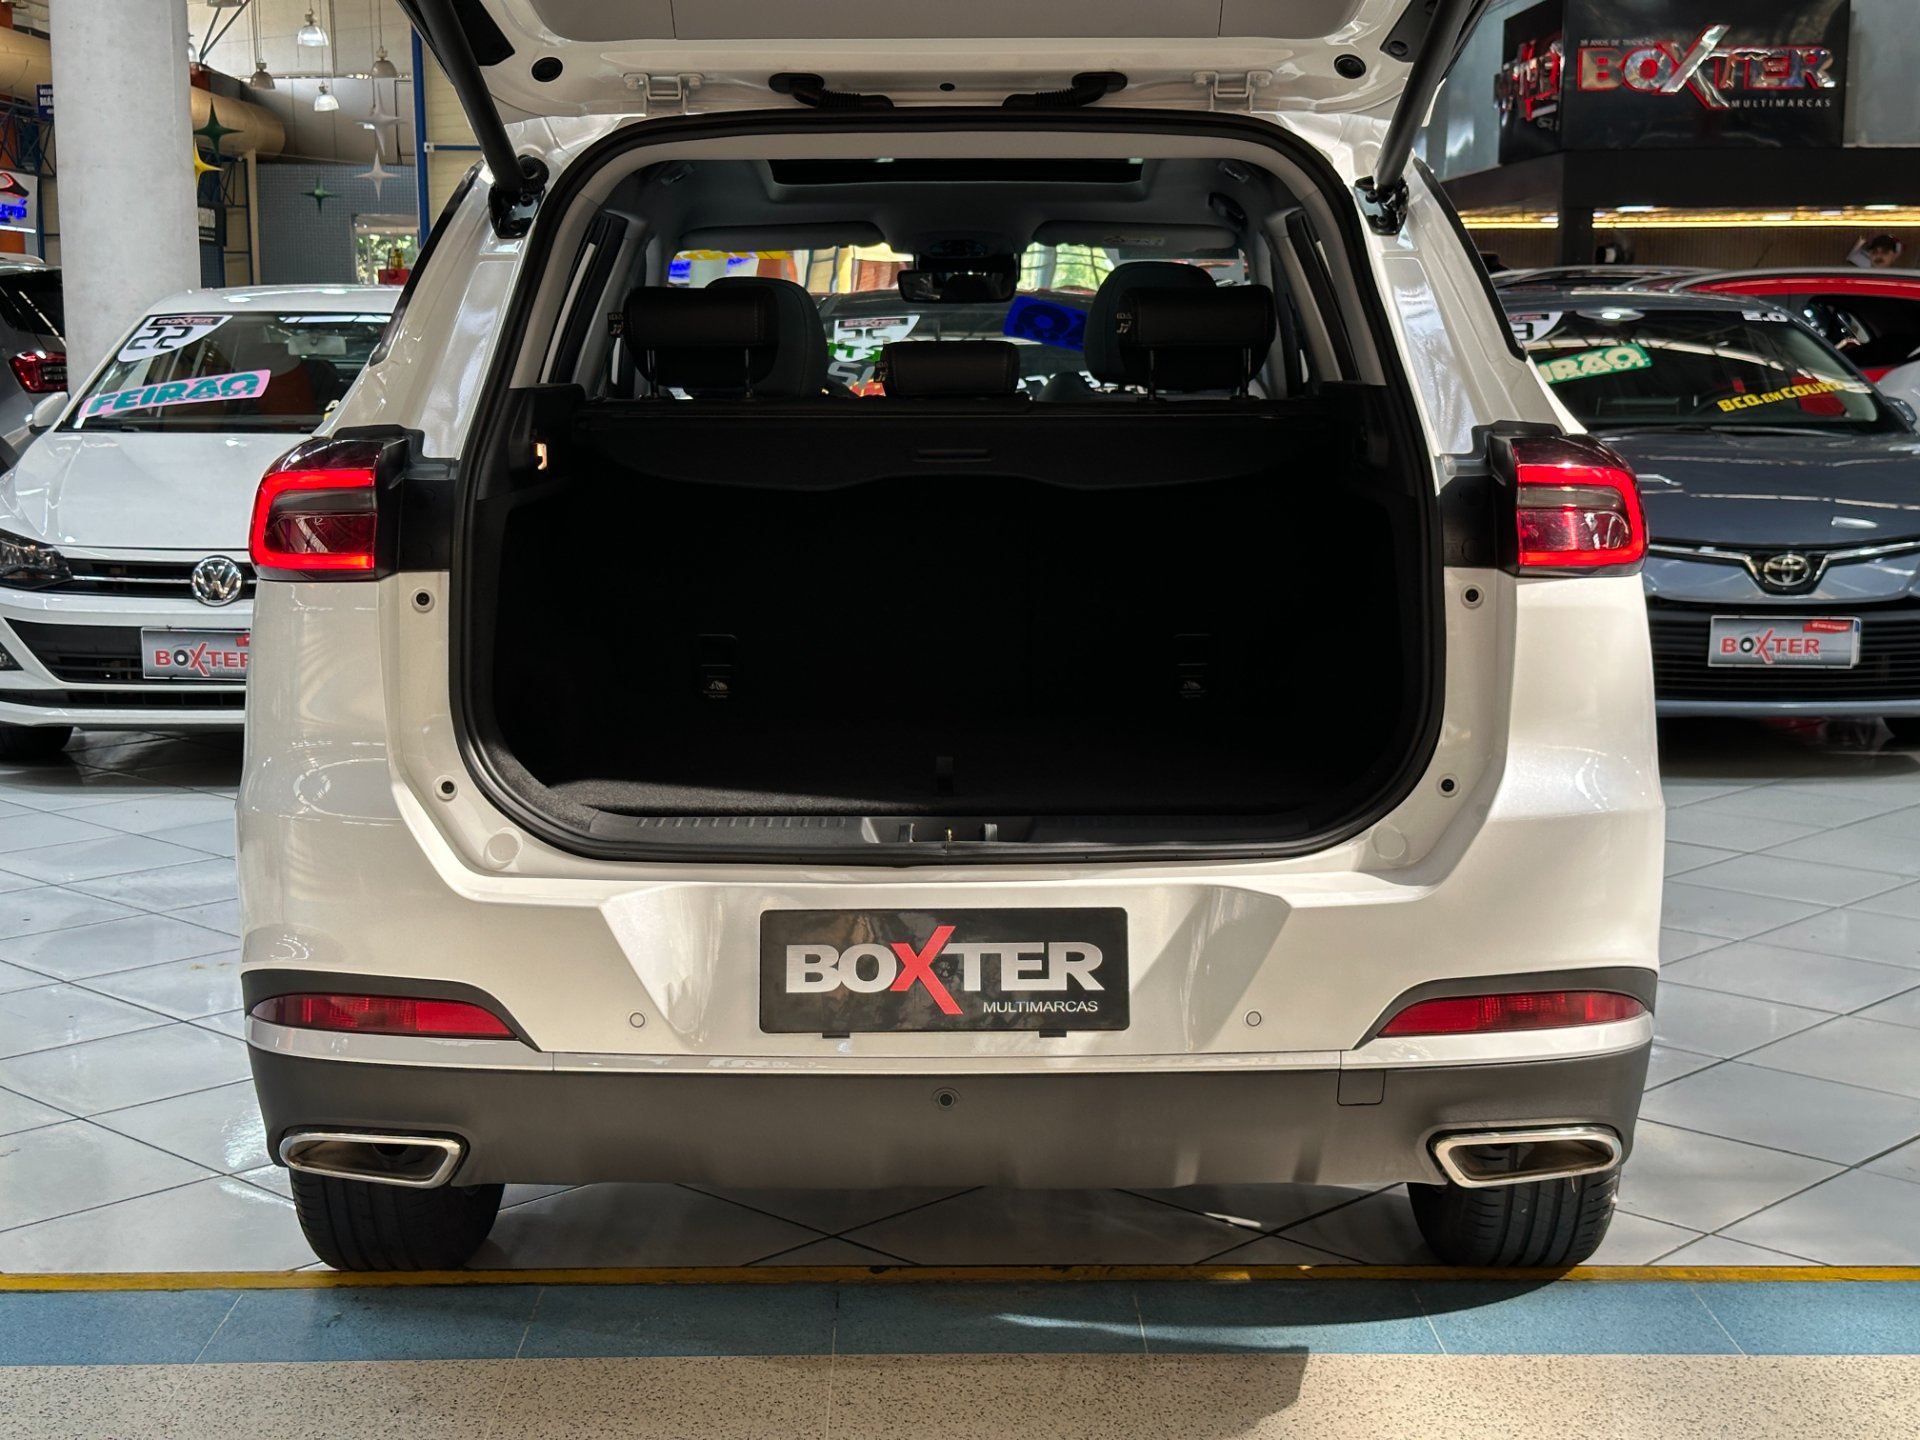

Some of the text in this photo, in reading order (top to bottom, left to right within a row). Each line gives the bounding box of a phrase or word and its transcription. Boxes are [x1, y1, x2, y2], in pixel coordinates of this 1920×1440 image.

[1578, 24, 1836, 110] BOXTER
[1731, 100, 1832, 109] MULTIMARCAS
[157, 317, 215, 326] BOXTER
[1511, 322, 1534, 341] 3
[126, 326, 194, 351] 22
[1536, 346, 1646, 383] IRÃO
[87, 373, 260, 414] FEIRÃO
[1720, 627, 1821, 664] BOXTER
[786, 925, 1105, 1015] BOXTER
[983, 1000, 1099, 1014] MULTIMARCAS
